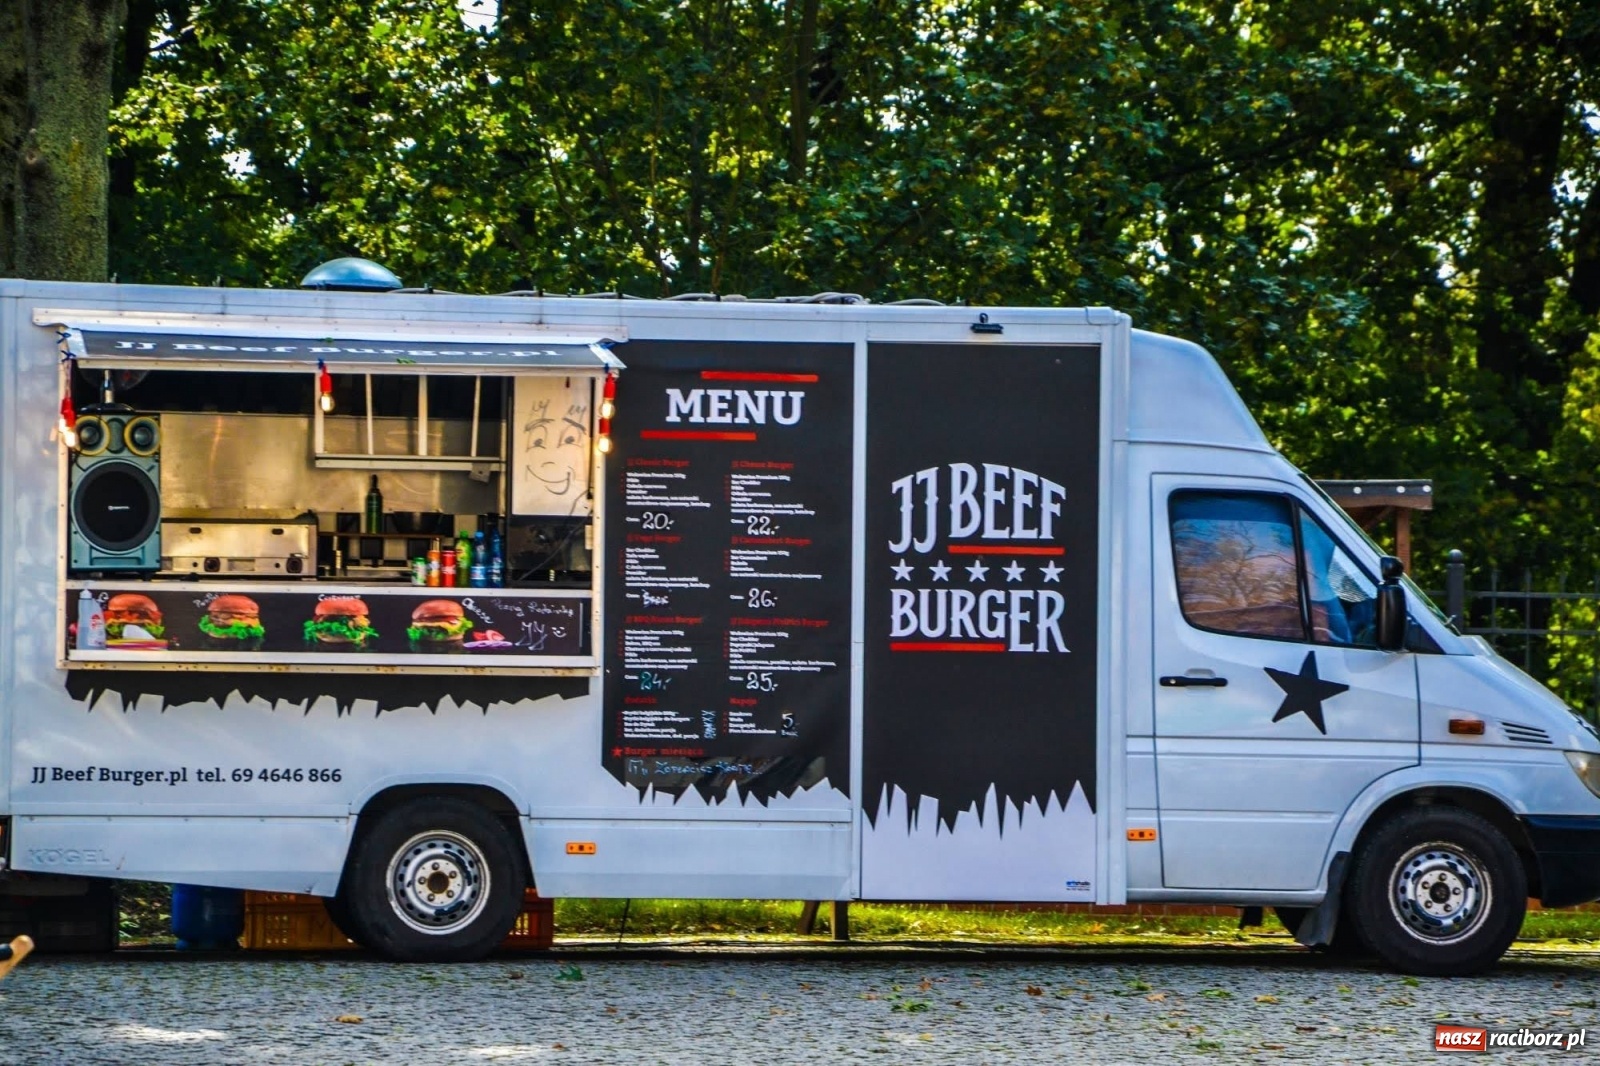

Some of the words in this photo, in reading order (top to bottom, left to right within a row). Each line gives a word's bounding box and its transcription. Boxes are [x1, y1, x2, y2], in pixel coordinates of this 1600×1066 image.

[115, 341, 157, 350] JJ
[172, 343, 297, 353] Beef
[665, 388, 805, 425] MENU
[888, 467, 939, 553] JJ
[948, 462, 1066, 539] BEEF
[889, 588, 1071, 653] BURGER
[31, 767, 46, 784] JJ
[51, 766, 96, 782] Beef
[99, 767, 188, 786] Burger.pl
[196, 767, 226, 783] tel.
[231, 768, 252, 783] 69
[258, 768, 303, 783] 4646
[308, 768, 342, 783] 866
